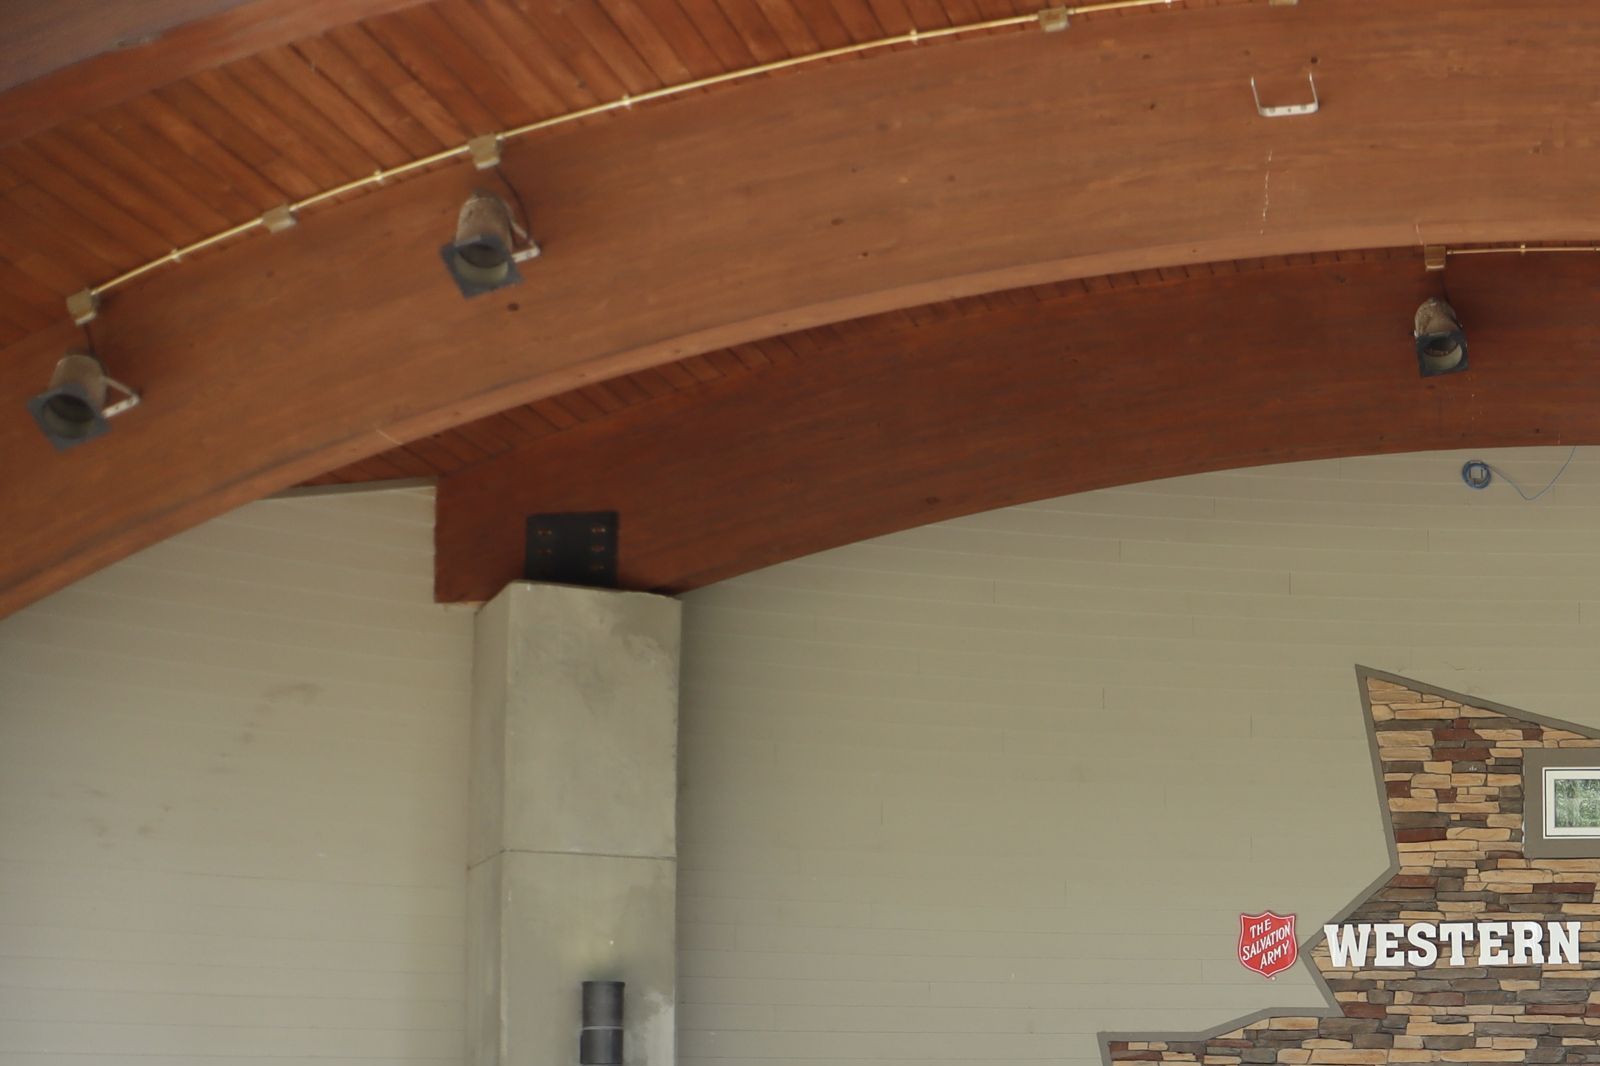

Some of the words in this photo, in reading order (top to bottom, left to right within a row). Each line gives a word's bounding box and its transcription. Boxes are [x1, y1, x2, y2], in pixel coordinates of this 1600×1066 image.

[1242, 921, 1291, 961] SALVATION
[1250, 918, 1272, 939] THE
[1324, 919, 1581, 968] WESTERN
[1260, 940, 1290, 970] ARMY
